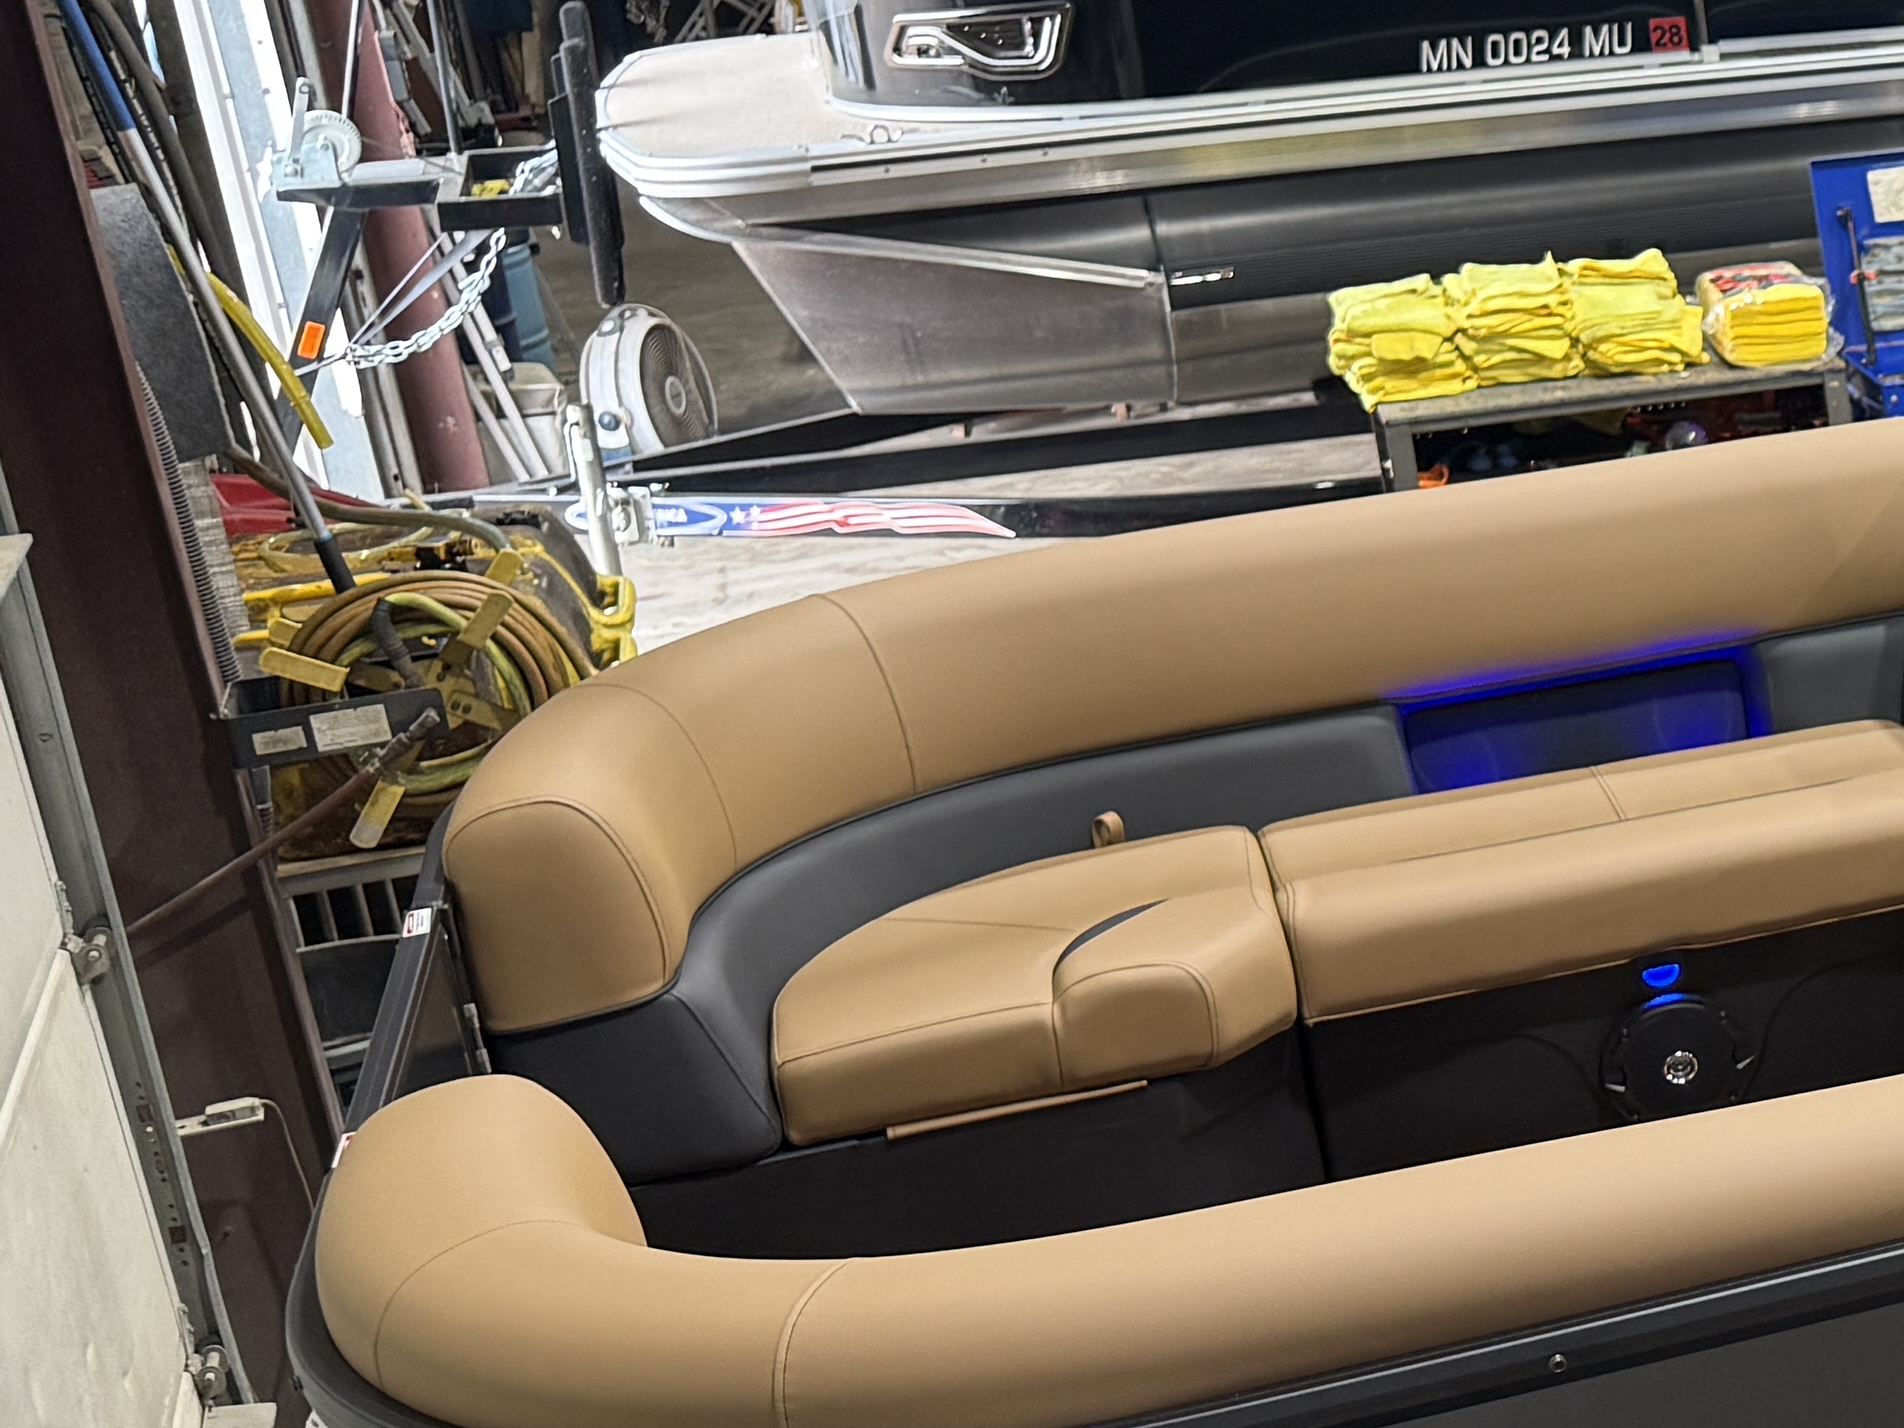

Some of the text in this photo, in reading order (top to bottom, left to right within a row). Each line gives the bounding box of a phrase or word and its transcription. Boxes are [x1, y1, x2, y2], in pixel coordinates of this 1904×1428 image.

[1421, 21, 1632, 72] MN 0024 MU
[1652, 24, 1684, 47] 28
